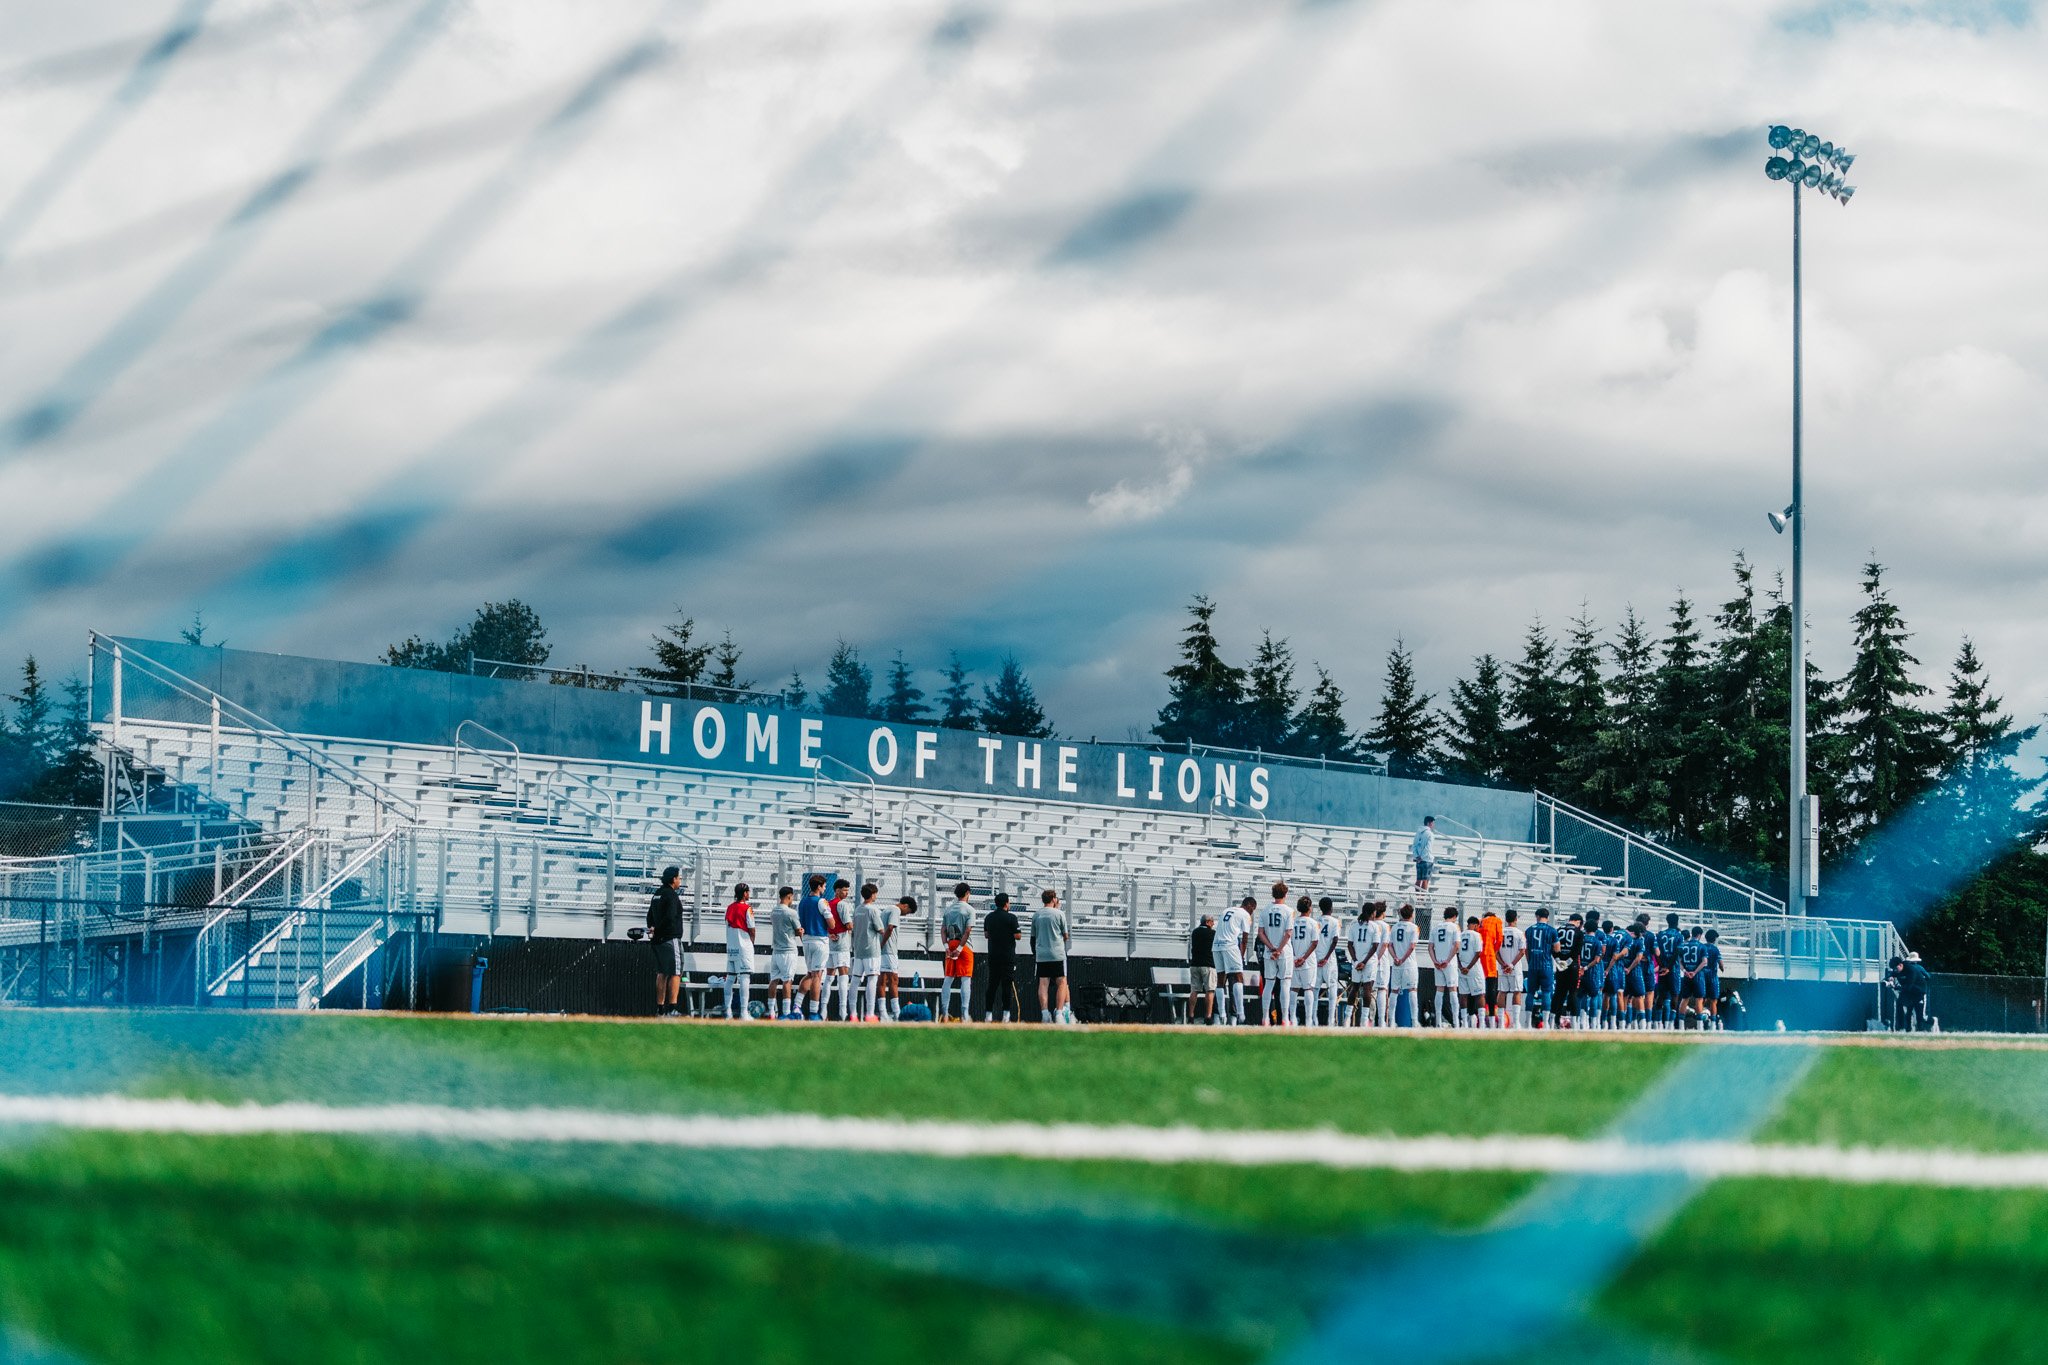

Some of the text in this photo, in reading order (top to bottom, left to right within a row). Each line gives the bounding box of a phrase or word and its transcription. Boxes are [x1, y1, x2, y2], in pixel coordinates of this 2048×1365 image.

[639, 700, 1269, 810] HOME OF THE LIONS
[1223, 911, 1234, 922] 6
[1268, 912, 1281, 928] 16
[1294, 925, 1306, 940] 15
[1320, 923, 1329, 937] 4
[1357, 928, 1368, 942] 11
[1396, 928, 1405, 942] 8
[1437, 928, 1446, 942] 2
[1461, 938, 1469, 951] 3
[1533, 929, 1543, 948] 4
[1558, 928, 1575, 948] 29
[1661, 934, 1675, 953] 21
[1682, 945, 1698, 963] 23
